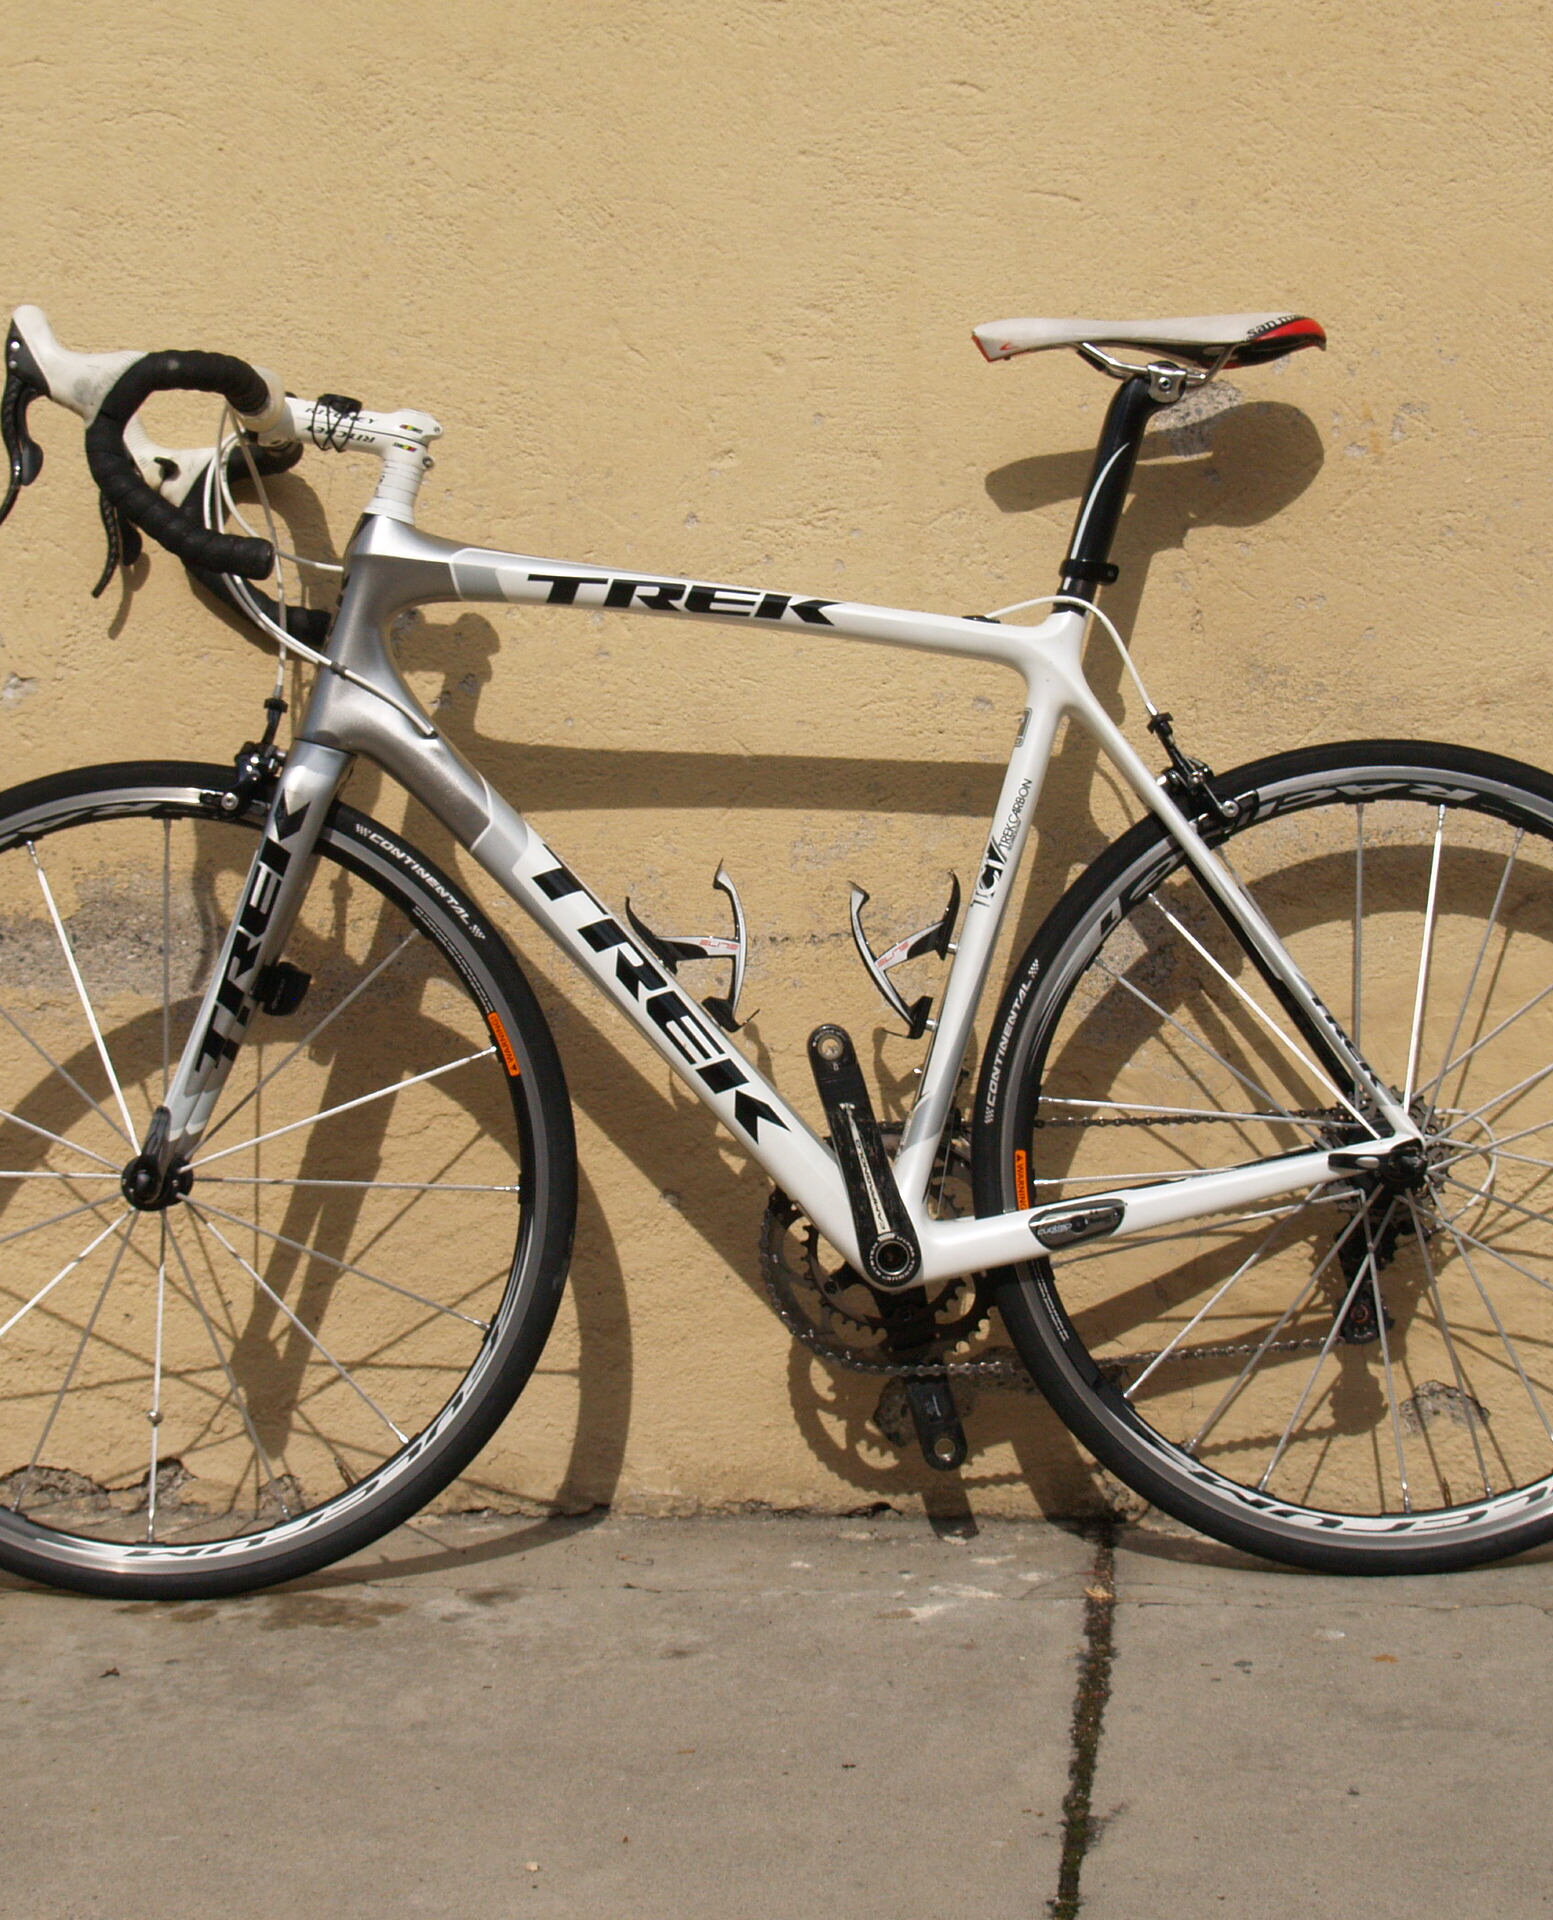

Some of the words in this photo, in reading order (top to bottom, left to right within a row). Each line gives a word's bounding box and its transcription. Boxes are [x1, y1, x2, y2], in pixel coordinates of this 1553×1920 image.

[528, 574, 845, 626] TREK
[1008, 778, 1032, 826] CARBON
[368, 832, 471, 926] CONTINENTAL
[195, 799, 312, 1073] TREK
[530, 845, 790, 1145] TREK
[987, 980, 1032, 1108] CONTINENTAL
